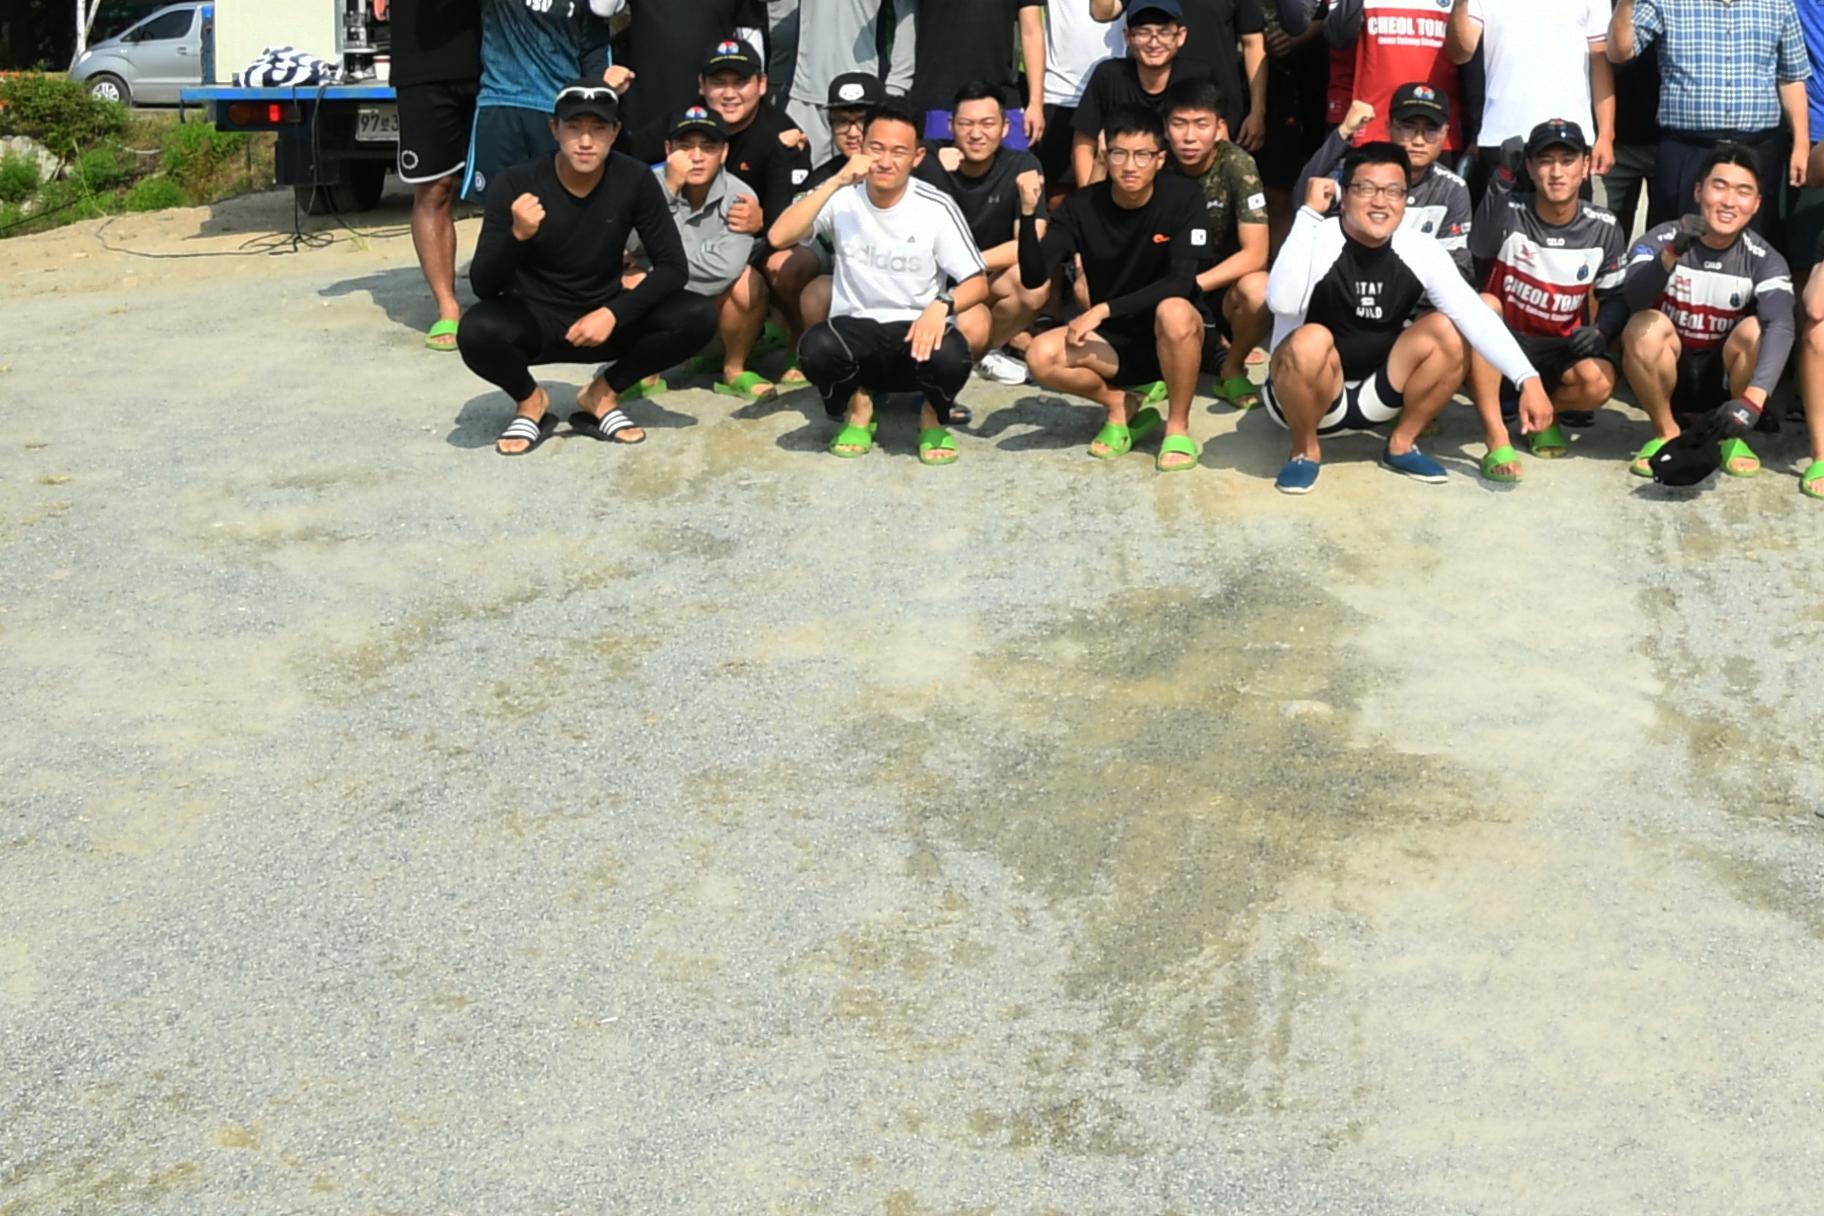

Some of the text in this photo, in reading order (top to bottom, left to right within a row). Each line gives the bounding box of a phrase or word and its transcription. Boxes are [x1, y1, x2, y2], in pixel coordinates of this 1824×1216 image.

[1367, 16, 1415, 36] CHEOL
[1355, 281, 1384, 295] STAY
[1503, 274, 1549, 309] CHEOL
[1355, 306, 1383, 319] WILD
